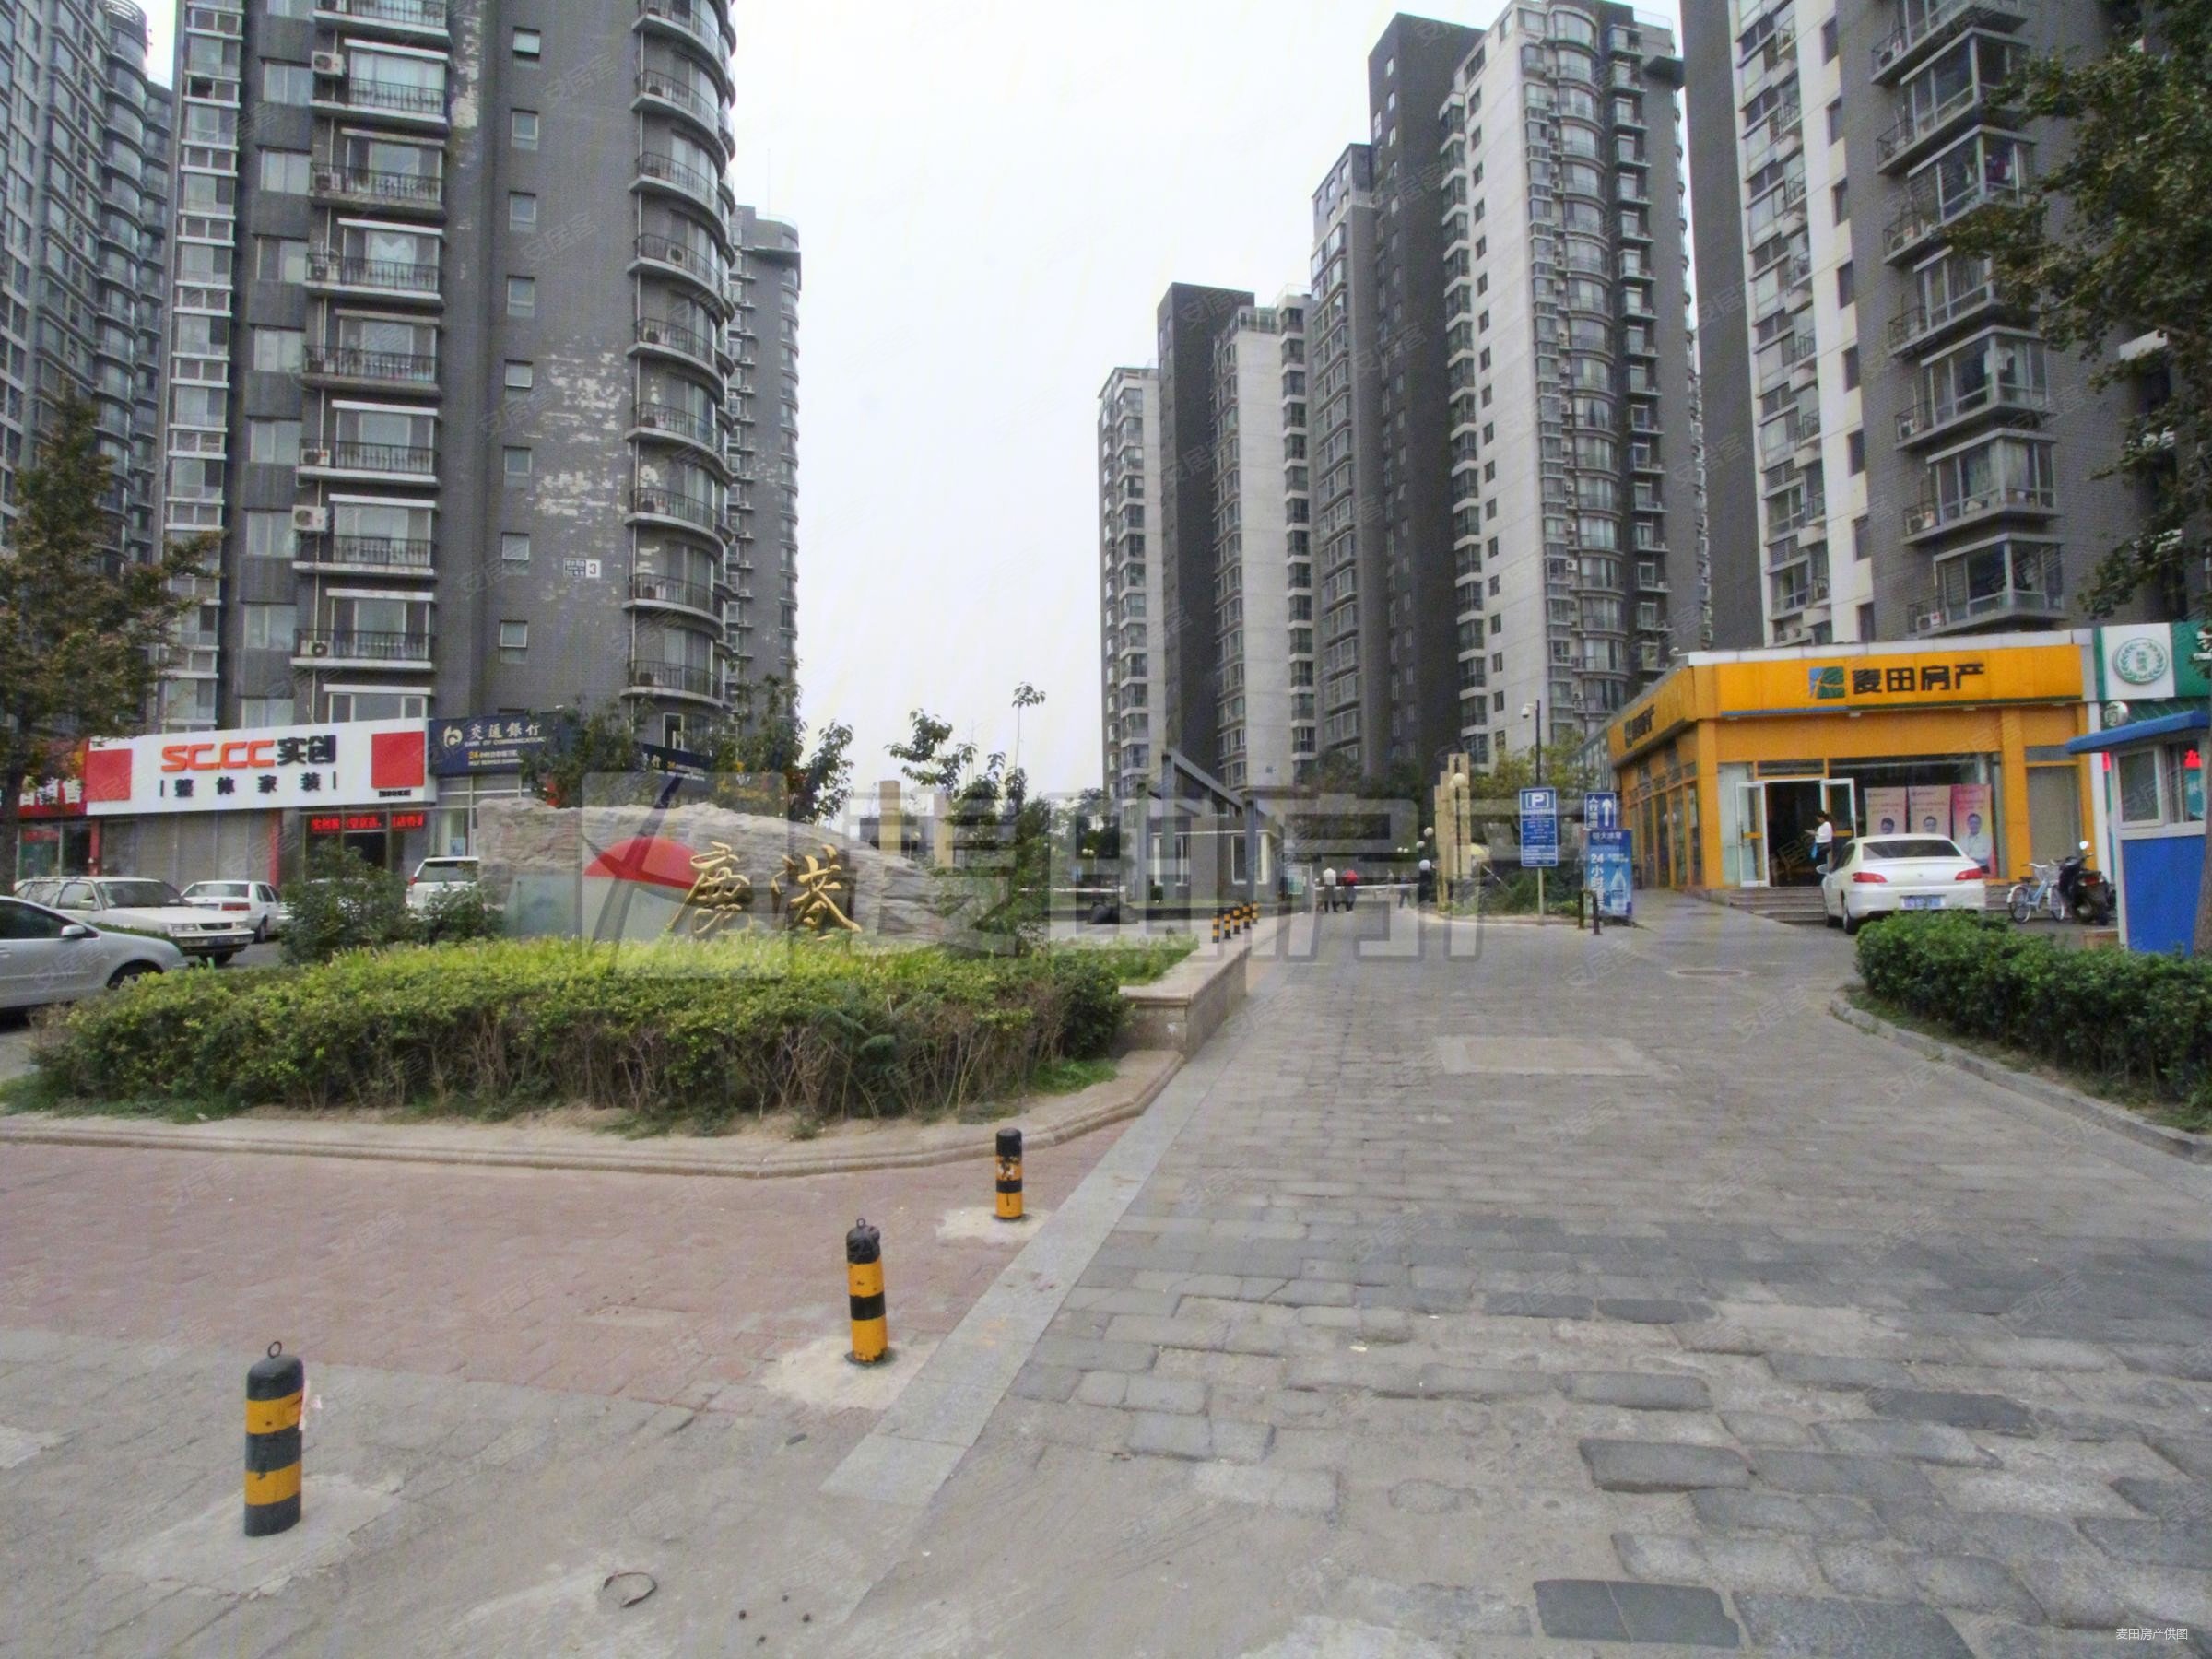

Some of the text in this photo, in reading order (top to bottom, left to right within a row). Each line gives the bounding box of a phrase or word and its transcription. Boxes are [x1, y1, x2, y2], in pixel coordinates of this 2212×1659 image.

[1852, 662, 1984, 695] 麦田房产
[174, 772, 321, 798] 整体家装
